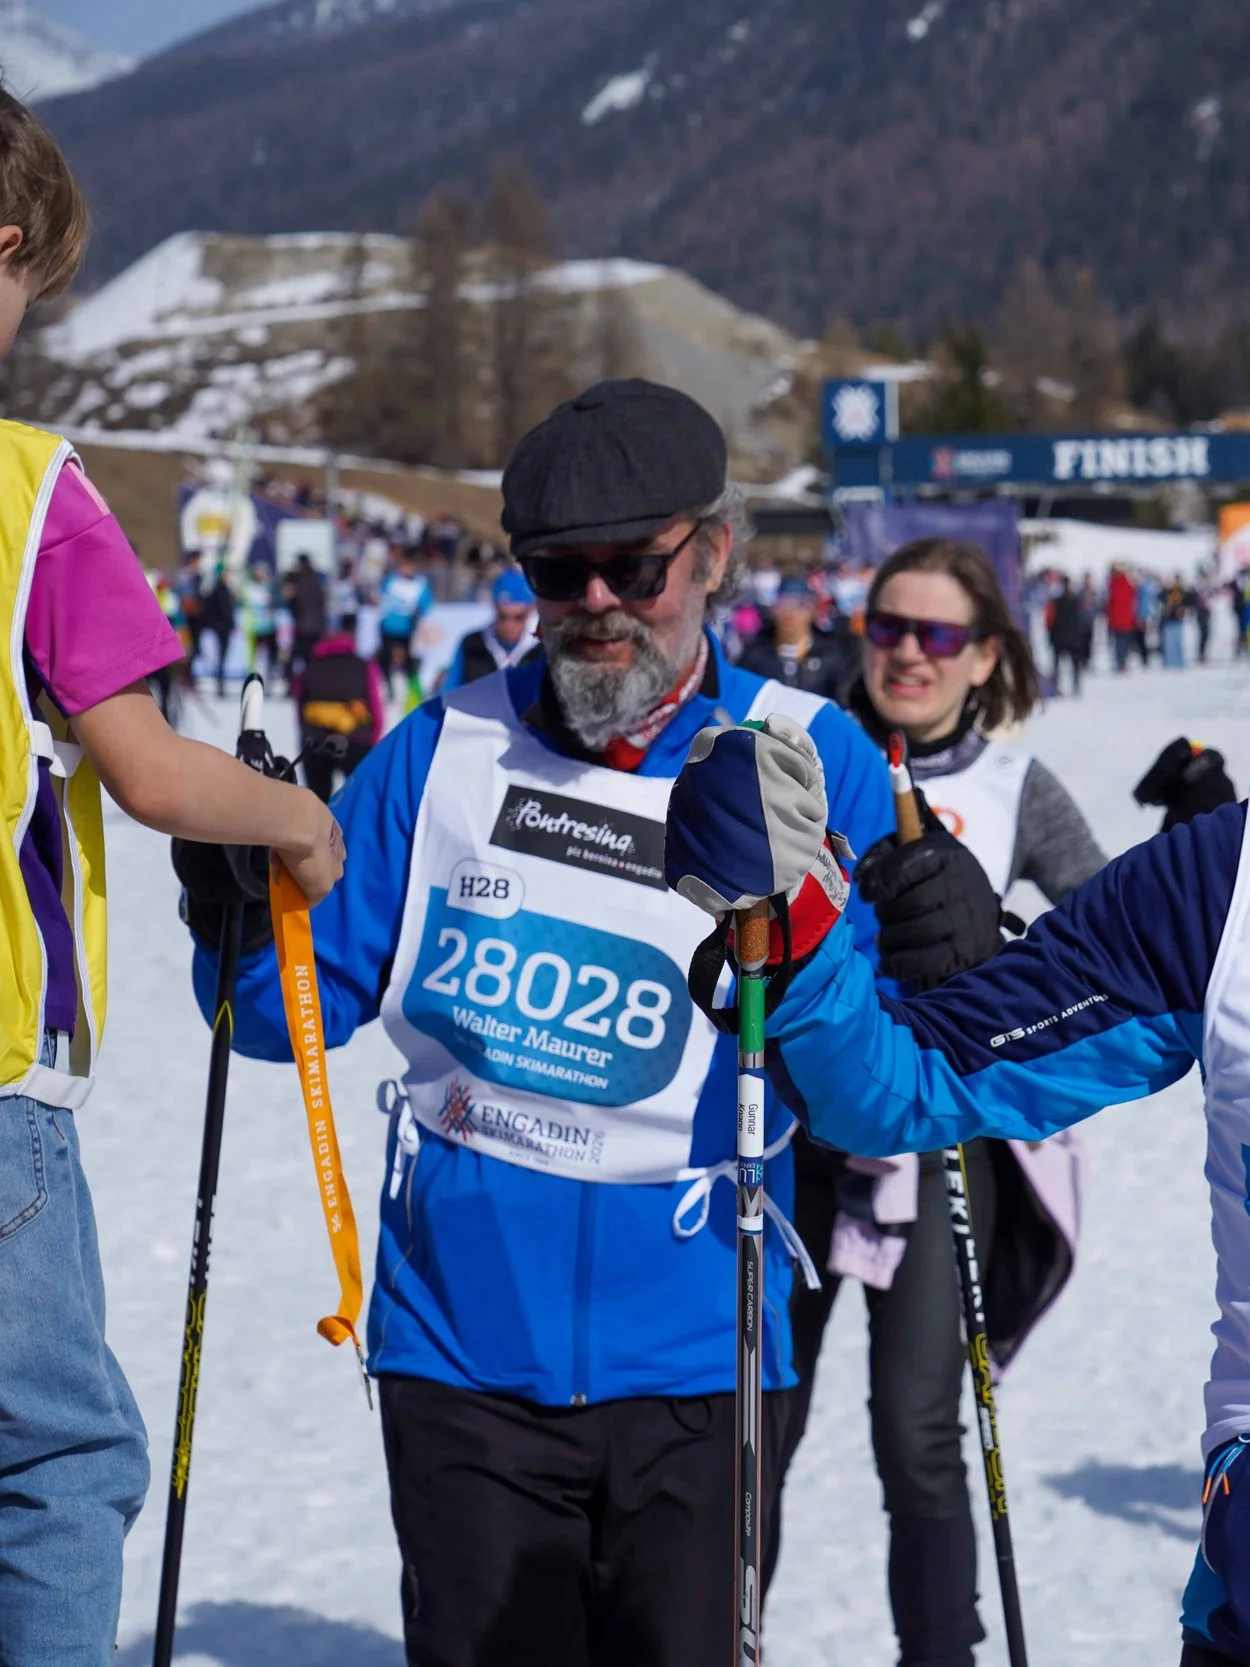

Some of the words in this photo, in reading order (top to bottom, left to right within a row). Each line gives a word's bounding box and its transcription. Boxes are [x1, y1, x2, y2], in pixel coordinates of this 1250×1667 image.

[1053, 437, 1209, 479] FINISH
[459, 875, 511, 899] H28
[422, 927, 673, 1050] 28028
[294, 964, 324, 1109] SKIMARATHON
[452, 1005, 522, 1042] Walter
[522, 1028, 614, 1070] Maurer
[1025, 1014, 1060, 1036] SPORTS
[515, 1055, 610, 1090] SKIMARATHON
[480, 1106, 591, 1146] ENGADIN
[747, 1103, 759, 1136] Gunnar
[314, 1119, 339, 1207] ENGADIN
[746, 1260, 754, 1292] SUPER
[746, 1292, 754, 1332] CARBON
